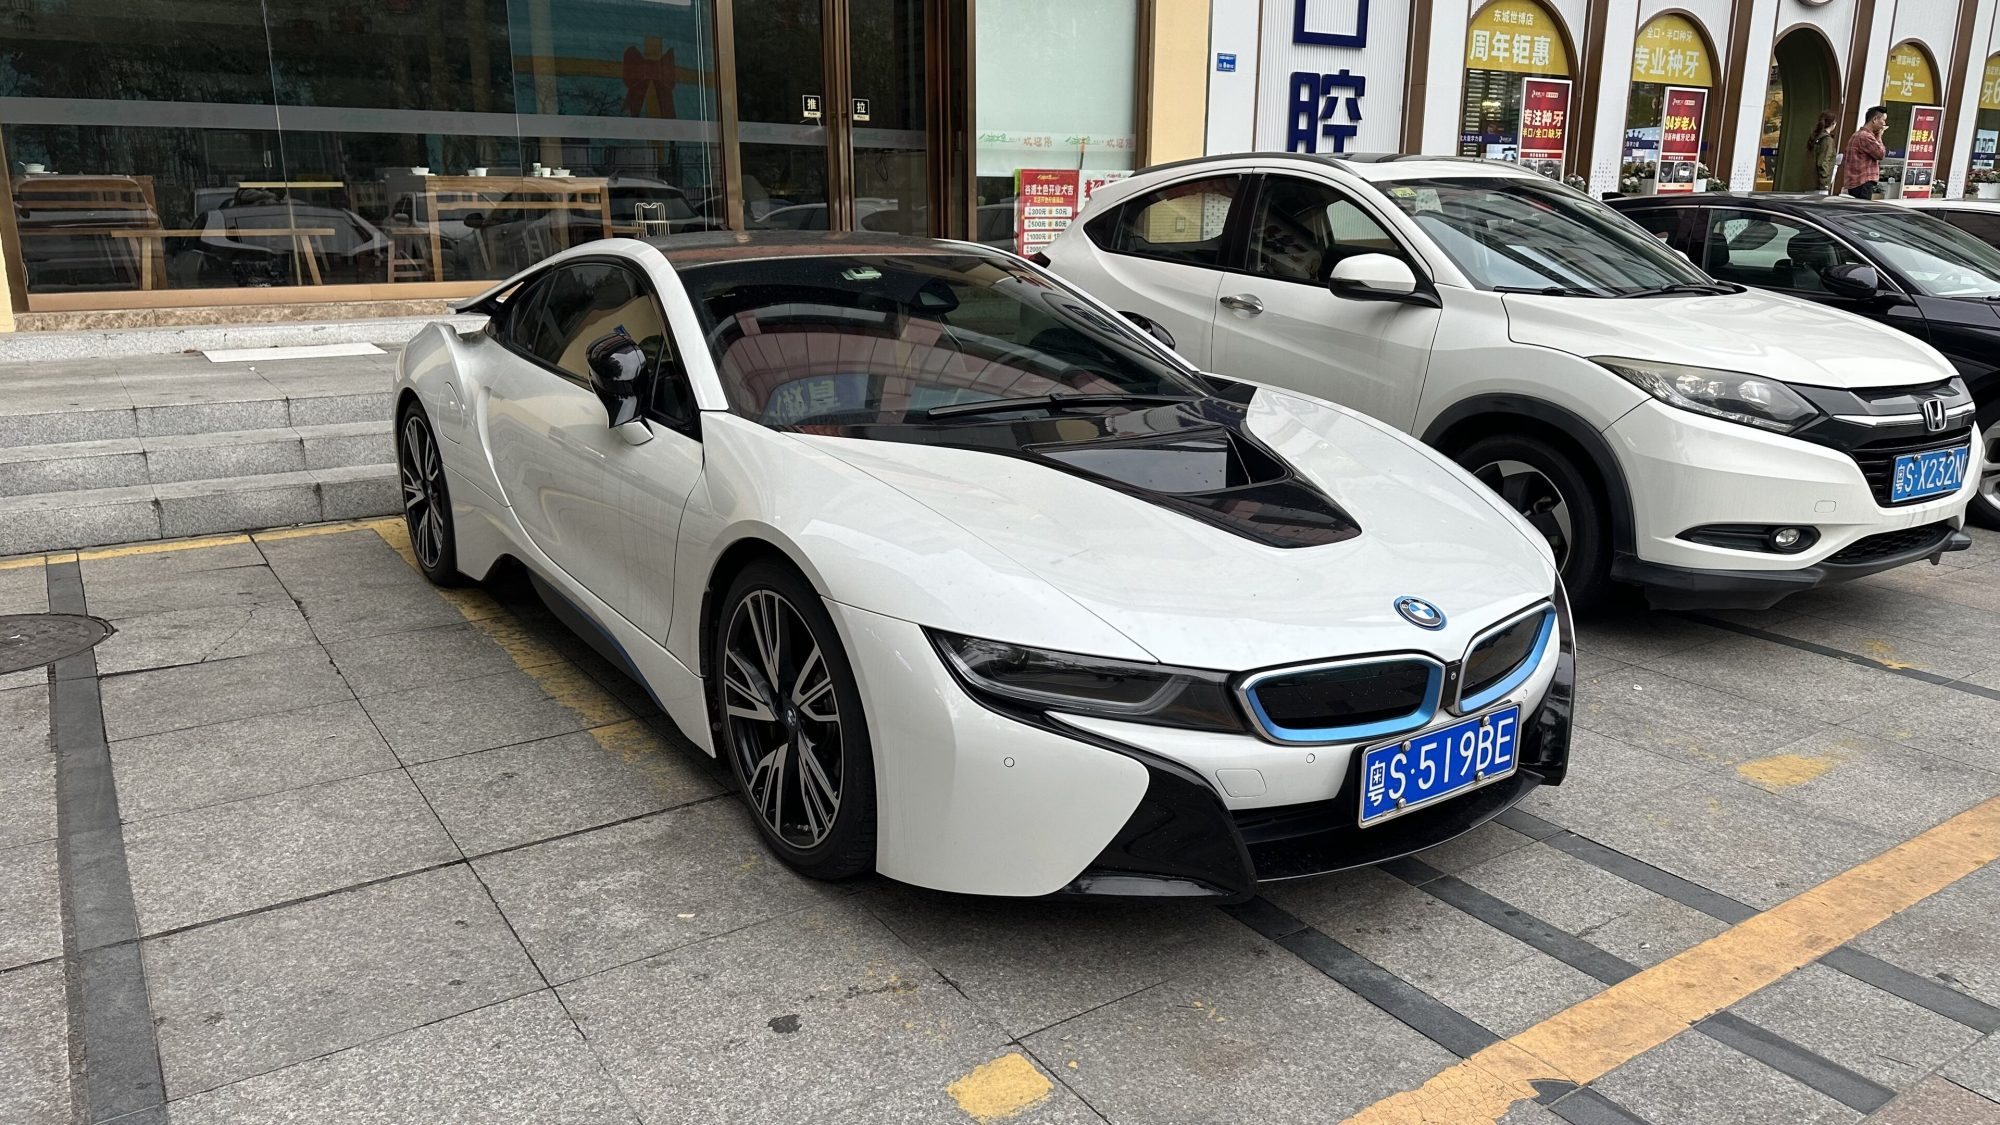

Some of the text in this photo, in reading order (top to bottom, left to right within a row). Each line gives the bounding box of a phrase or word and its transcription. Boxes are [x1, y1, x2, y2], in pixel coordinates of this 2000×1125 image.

[1494, 9, 1534, 26] 东城世博店
[1470, 30, 1551, 66] 周年钜惠
[1634, 45, 1699, 79] 专业种牙
[807, 98, 817, 110] 推
[856, 101, 866, 113] 拉
[1524, 109, 1564, 127] 专注种牙
[1665, 116, 1697, 131] 94岁老人
[1896, 454, 1965, 494] 粤S·X232N
[1368, 717, 1514, 807] 粤S·519BE
